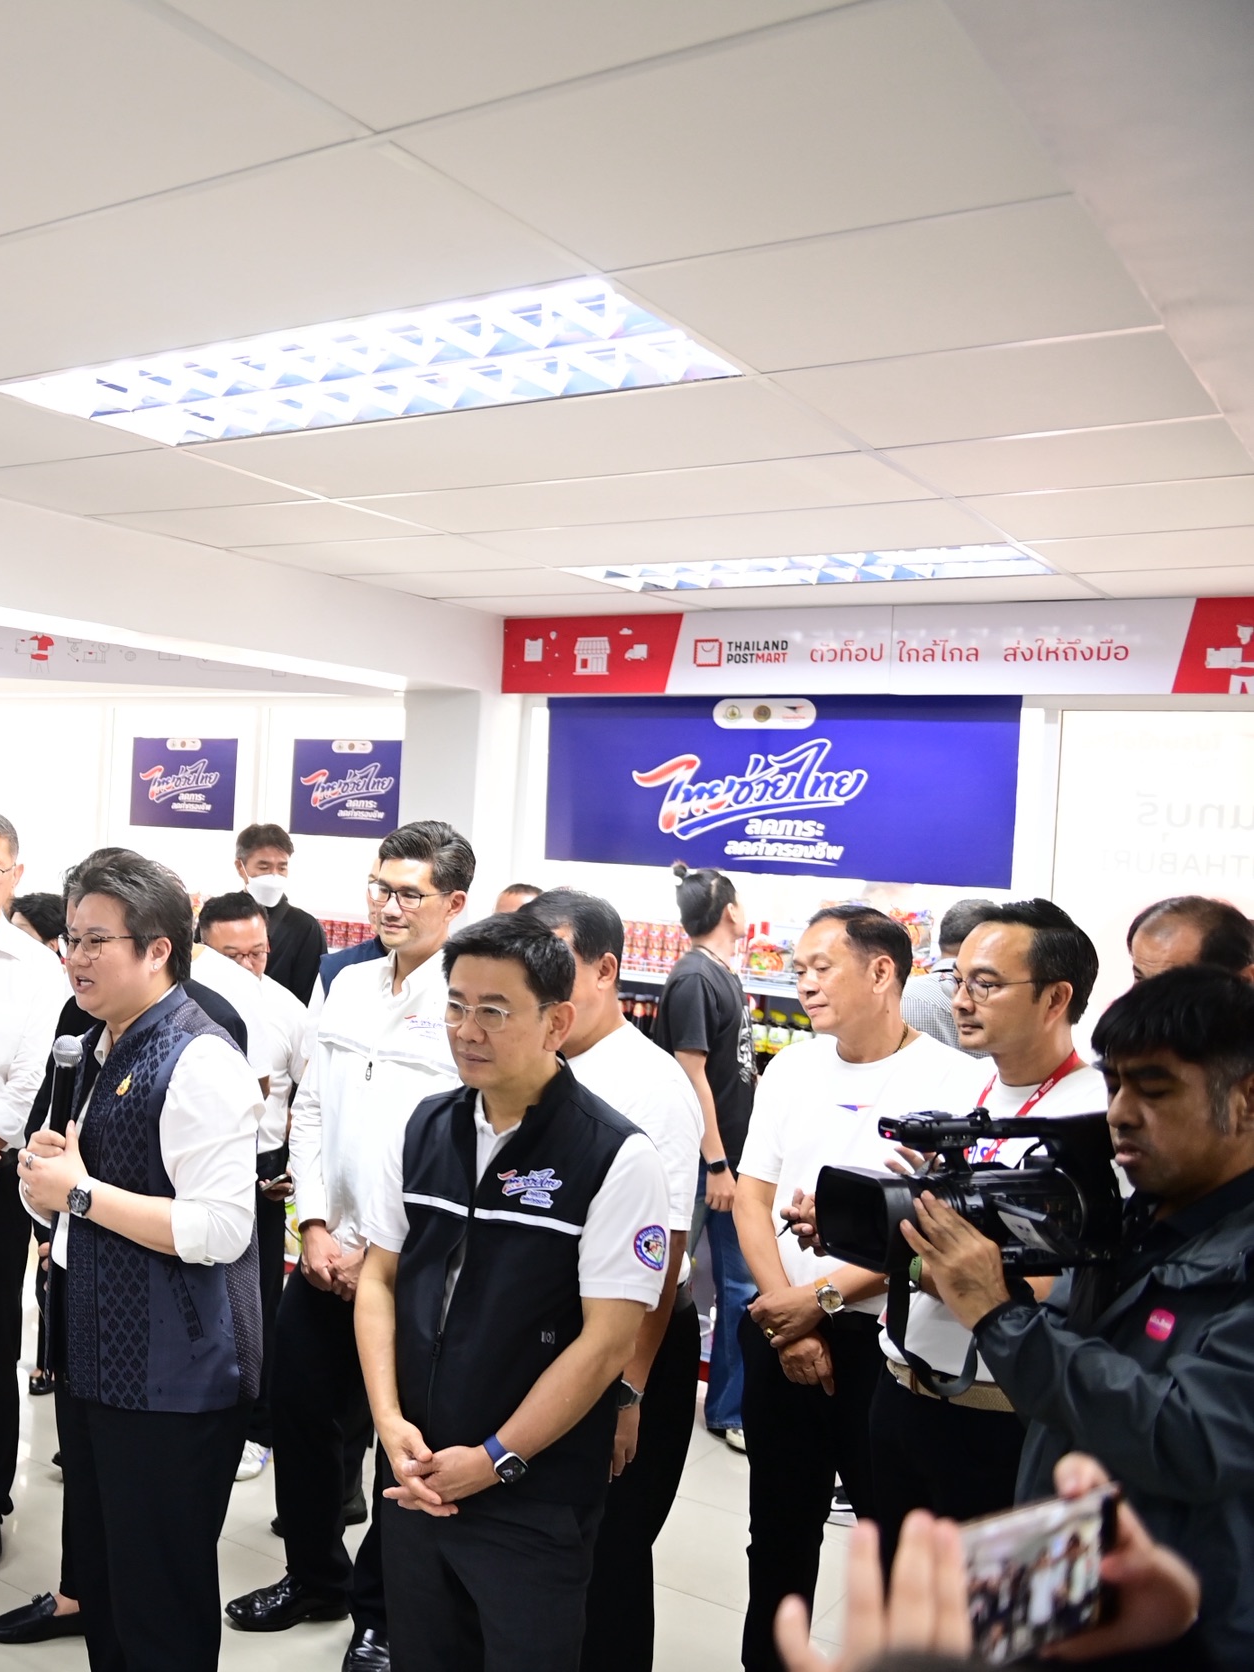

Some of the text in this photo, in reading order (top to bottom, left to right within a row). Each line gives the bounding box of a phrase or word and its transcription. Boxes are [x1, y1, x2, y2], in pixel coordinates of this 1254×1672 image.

[727, 640, 789, 652] THAILAND
[809, 638, 1130, 663] ตัวท็อป ใกล้ไกล ส่งให้ถึงมือ
[727, 652, 788, 664] POSTMART
[632, 738, 868, 834] ไทยช่วยไทย
[745, 818, 826, 838] ลดภาระ
[723, 839, 845, 861] ลดค่าครองชีพ
